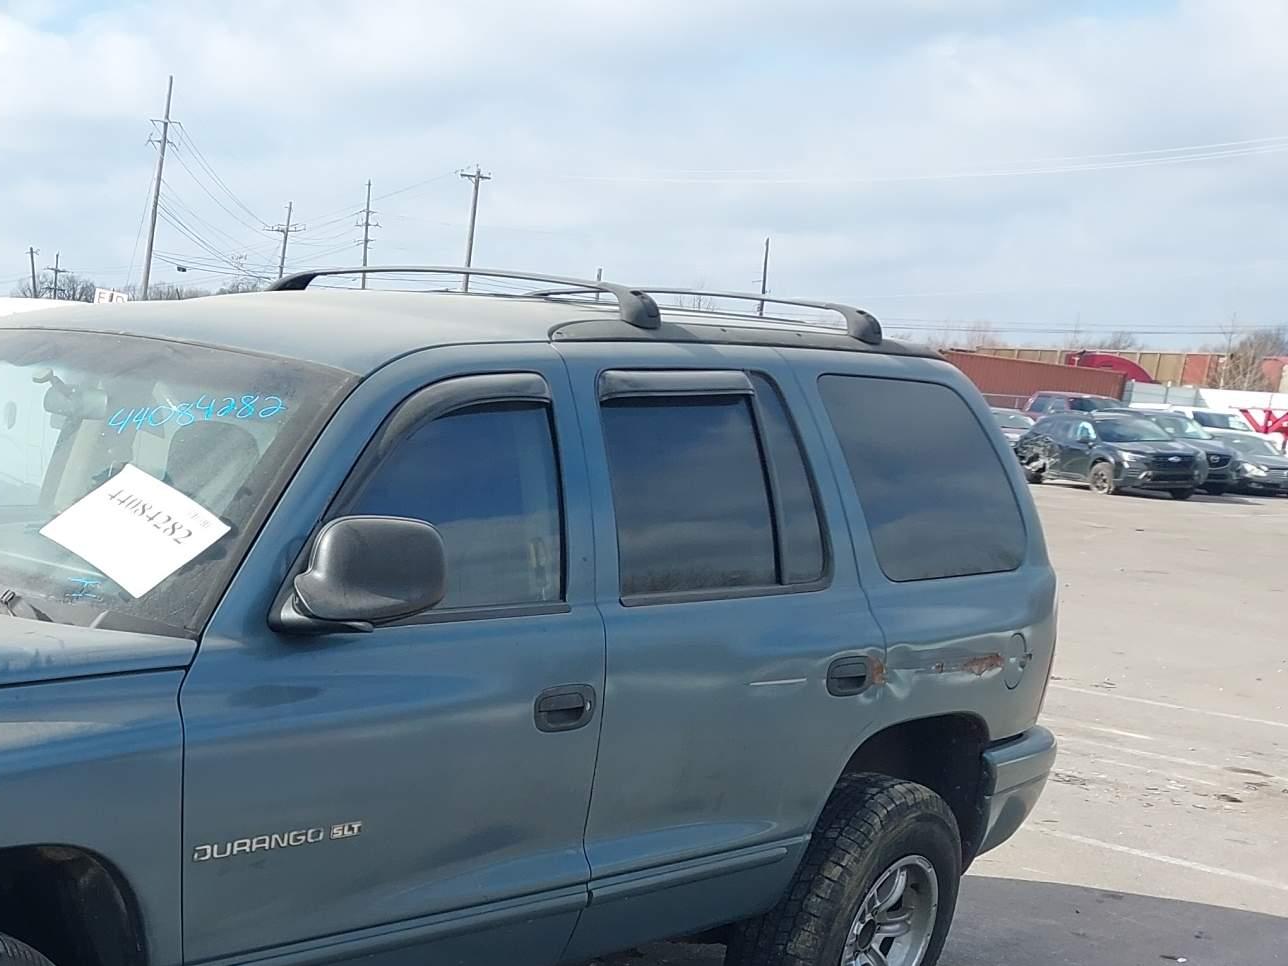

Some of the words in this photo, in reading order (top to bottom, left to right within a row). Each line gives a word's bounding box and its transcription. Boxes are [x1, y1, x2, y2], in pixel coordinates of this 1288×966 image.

[108, 394, 287, 434] 44084282
[107, 488, 193, 545] 44084282
[192, 827, 325, 863] DURANGO
[330, 820, 363, 840] SLT
